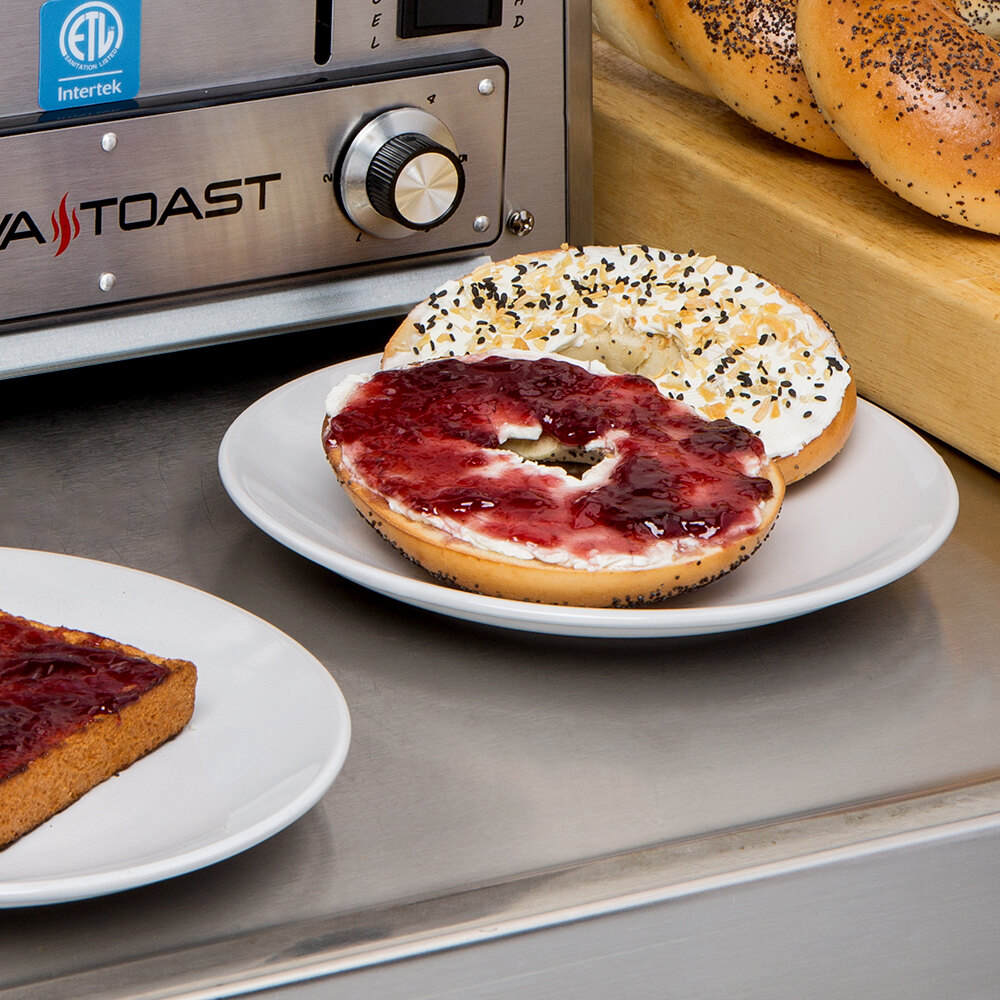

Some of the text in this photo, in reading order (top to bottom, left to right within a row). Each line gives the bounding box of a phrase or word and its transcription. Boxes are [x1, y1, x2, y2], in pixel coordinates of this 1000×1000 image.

[64, 54, 98, 71] SANITATION
[98, 48, 118, 68] LISTED
[58, 79, 122, 102] Intertek
[426, 93, 437, 105] 4
